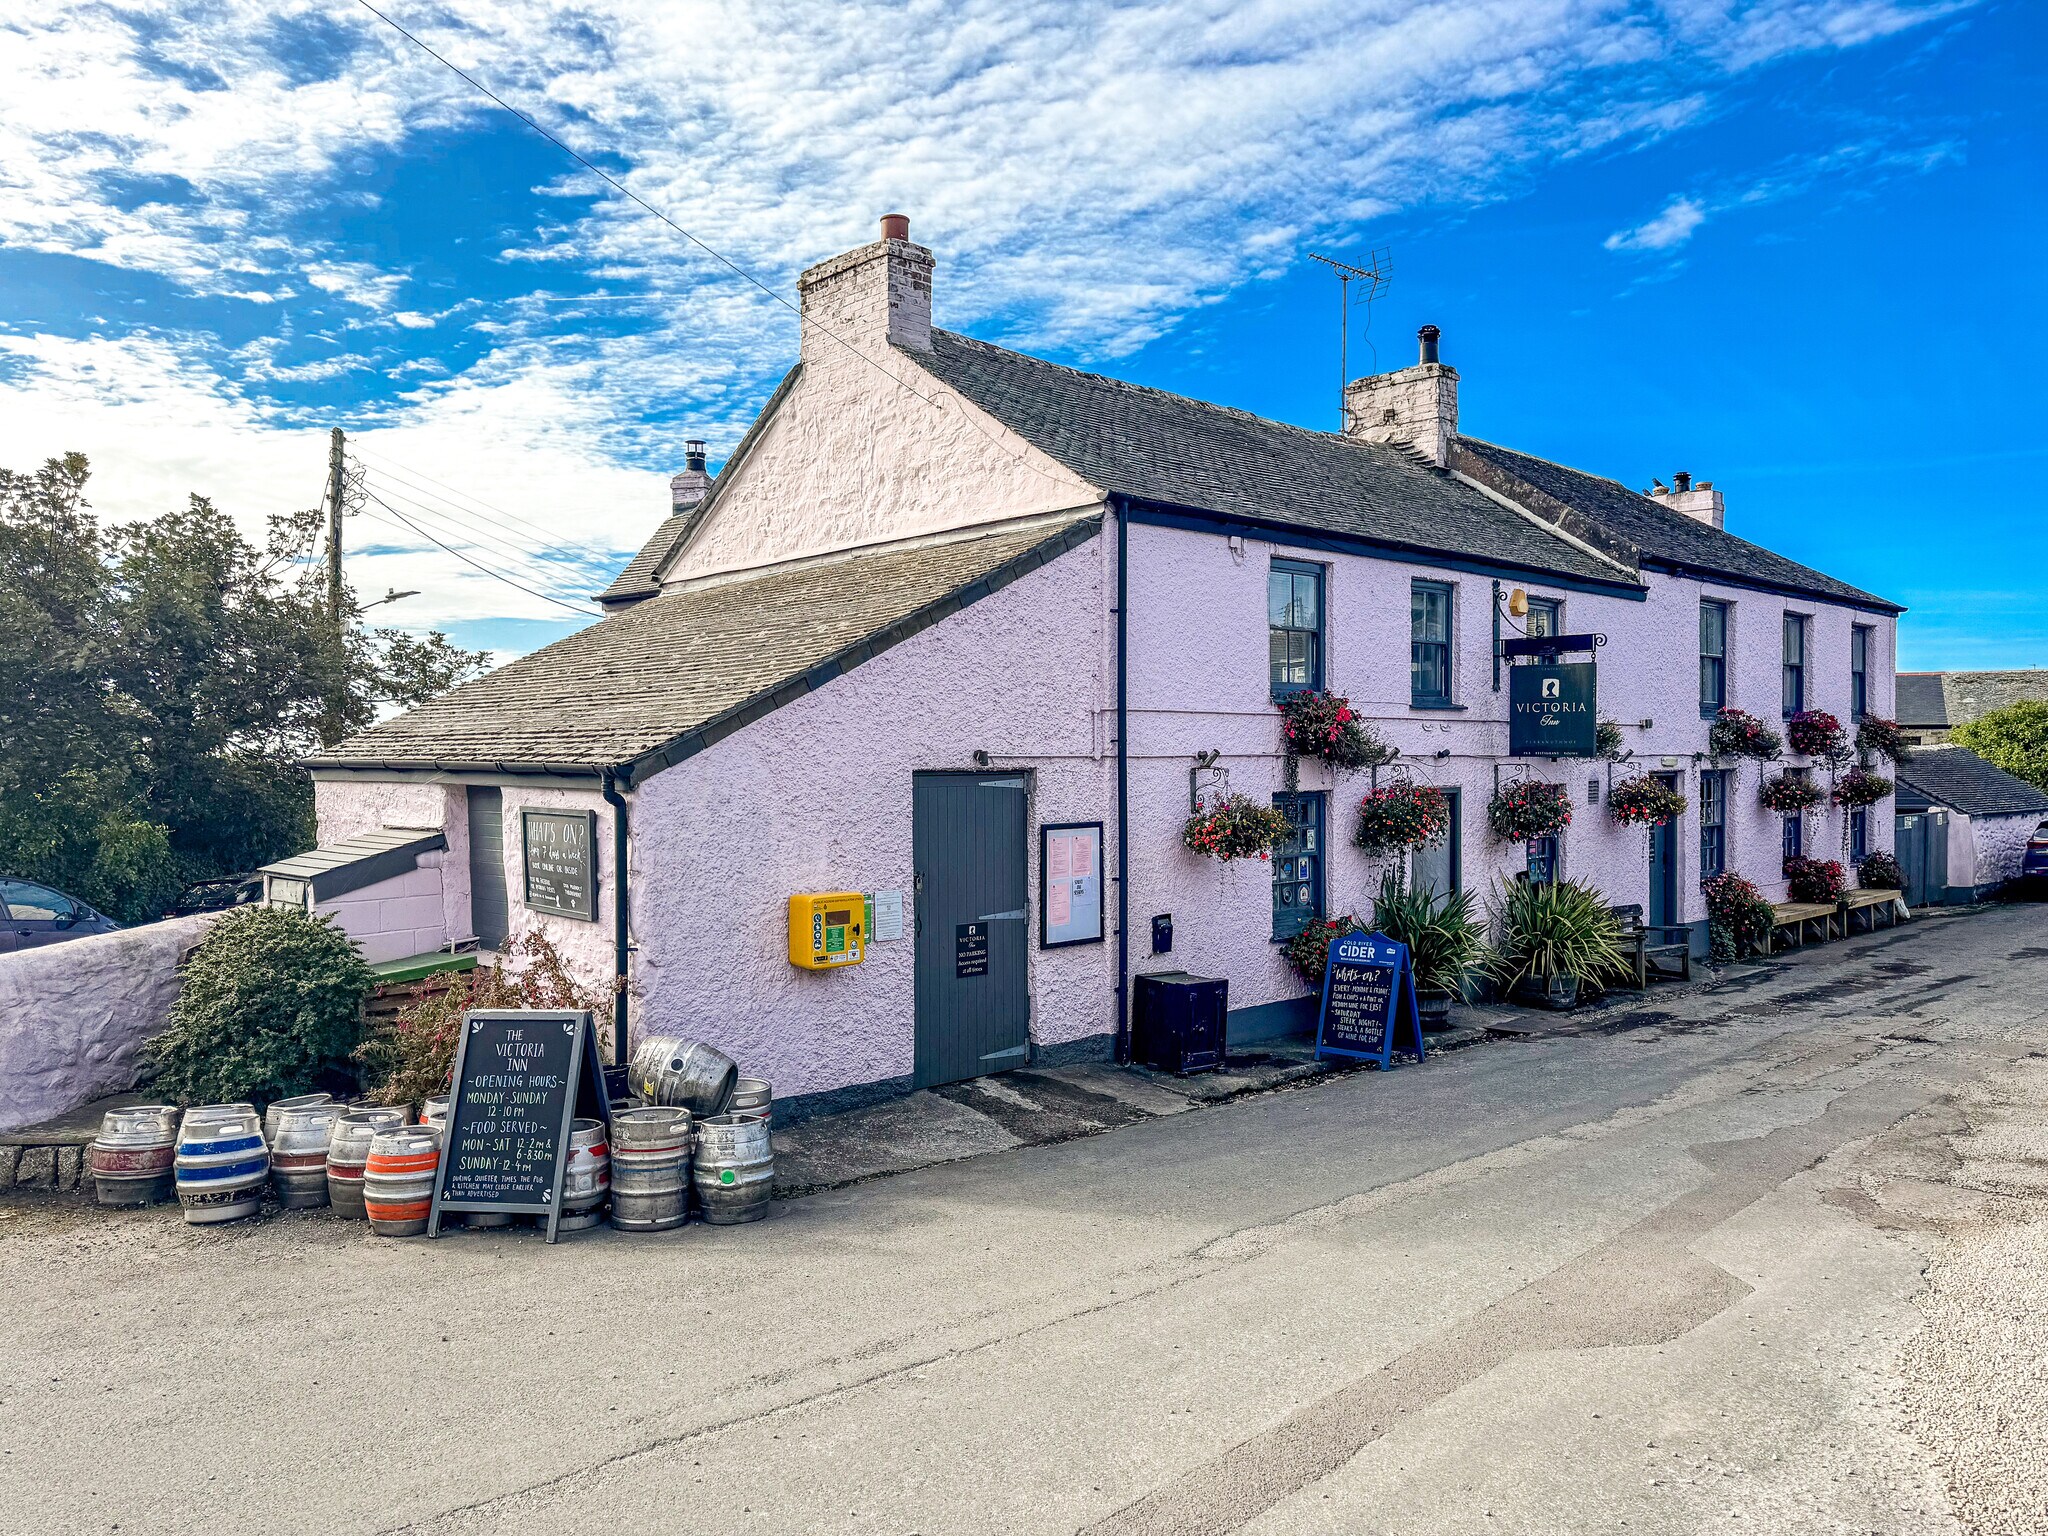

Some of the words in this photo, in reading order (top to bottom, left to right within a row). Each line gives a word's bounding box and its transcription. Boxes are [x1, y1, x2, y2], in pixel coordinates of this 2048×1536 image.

[1516, 702, 1587, 713] VICTORIA
[1540, 714, 1560, 726] Inn
[528, 821, 556, 842] WHAT'S
[563, 823, 584, 845] ON?
[542, 862, 554, 872] ONLINE
[564, 866, 578, 875] INSIDE
[1338, 945, 1376, 959] CIDER
[971, 957, 987, 965] required
[1340, 1017, 1356, 1025] STEAK
[506, 1029, 524, 1041] THE
[1359, 1034, 1367, 1042] FOR
[1365, 1028, 1383, 1036] BOTTLE
[496, 1043, 545, 1057] VICTORIA
[506, 1058, 528, 1071] INN
[462, 1139, 484, 1150] MON
[493, 1138, 511, 1150] SAT
[546, 1139, 551, 1148] &
[475, 1175, 498, 1183] QUIETER
